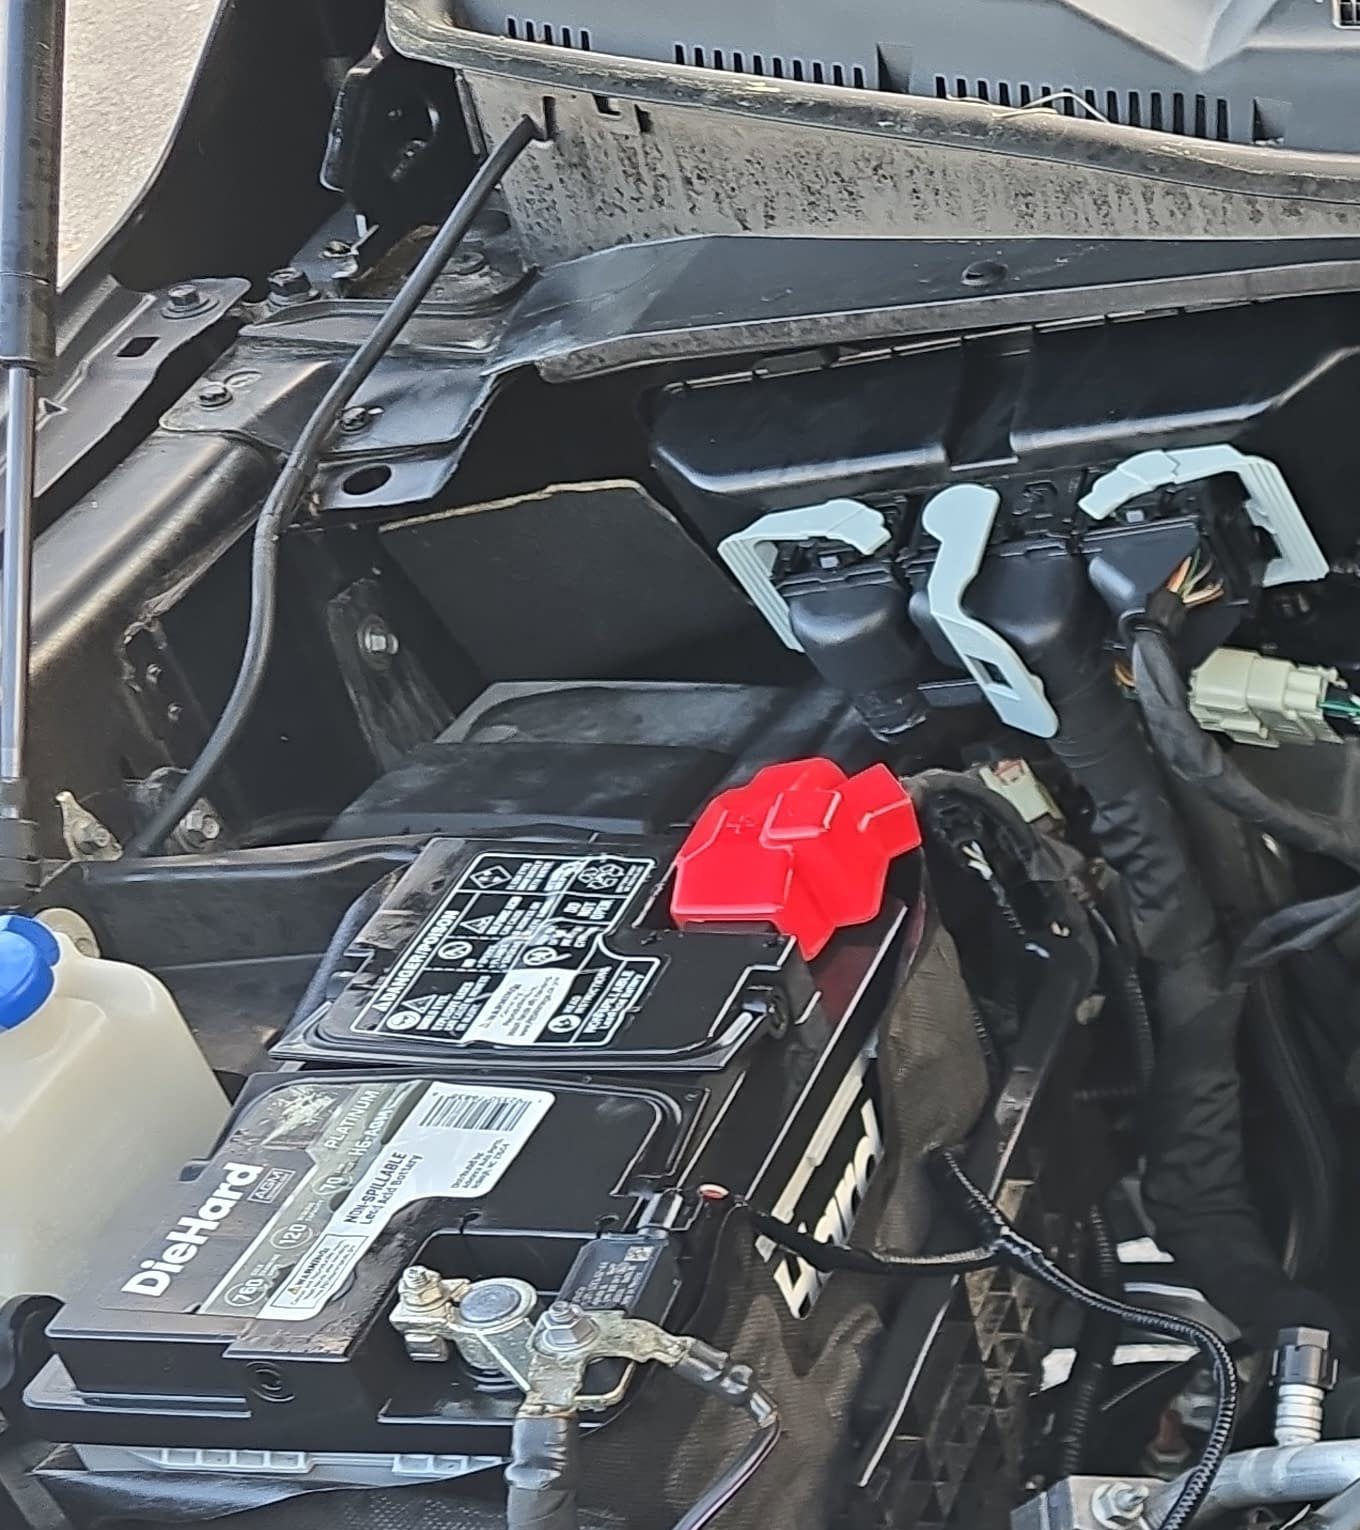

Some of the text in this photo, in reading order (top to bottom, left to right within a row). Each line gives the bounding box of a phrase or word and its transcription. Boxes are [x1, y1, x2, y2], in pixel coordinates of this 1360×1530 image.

[385, 910, 460, 1003] DANGER/POISON
[322, 1089, 382, 1148] PLATINUM
[252, 1170, 284, 1199] AGM
[321, 1175, 344, 1193] 70
[342, 1152, 408, 1222] NON-SPILLABLE
[376, 1187, 397, 1203] Acid
[118, 1160, 265, 1298] DieHard
[278, 1223, 308, 1244] 120
[231, 1278, 265, 1302] 760
